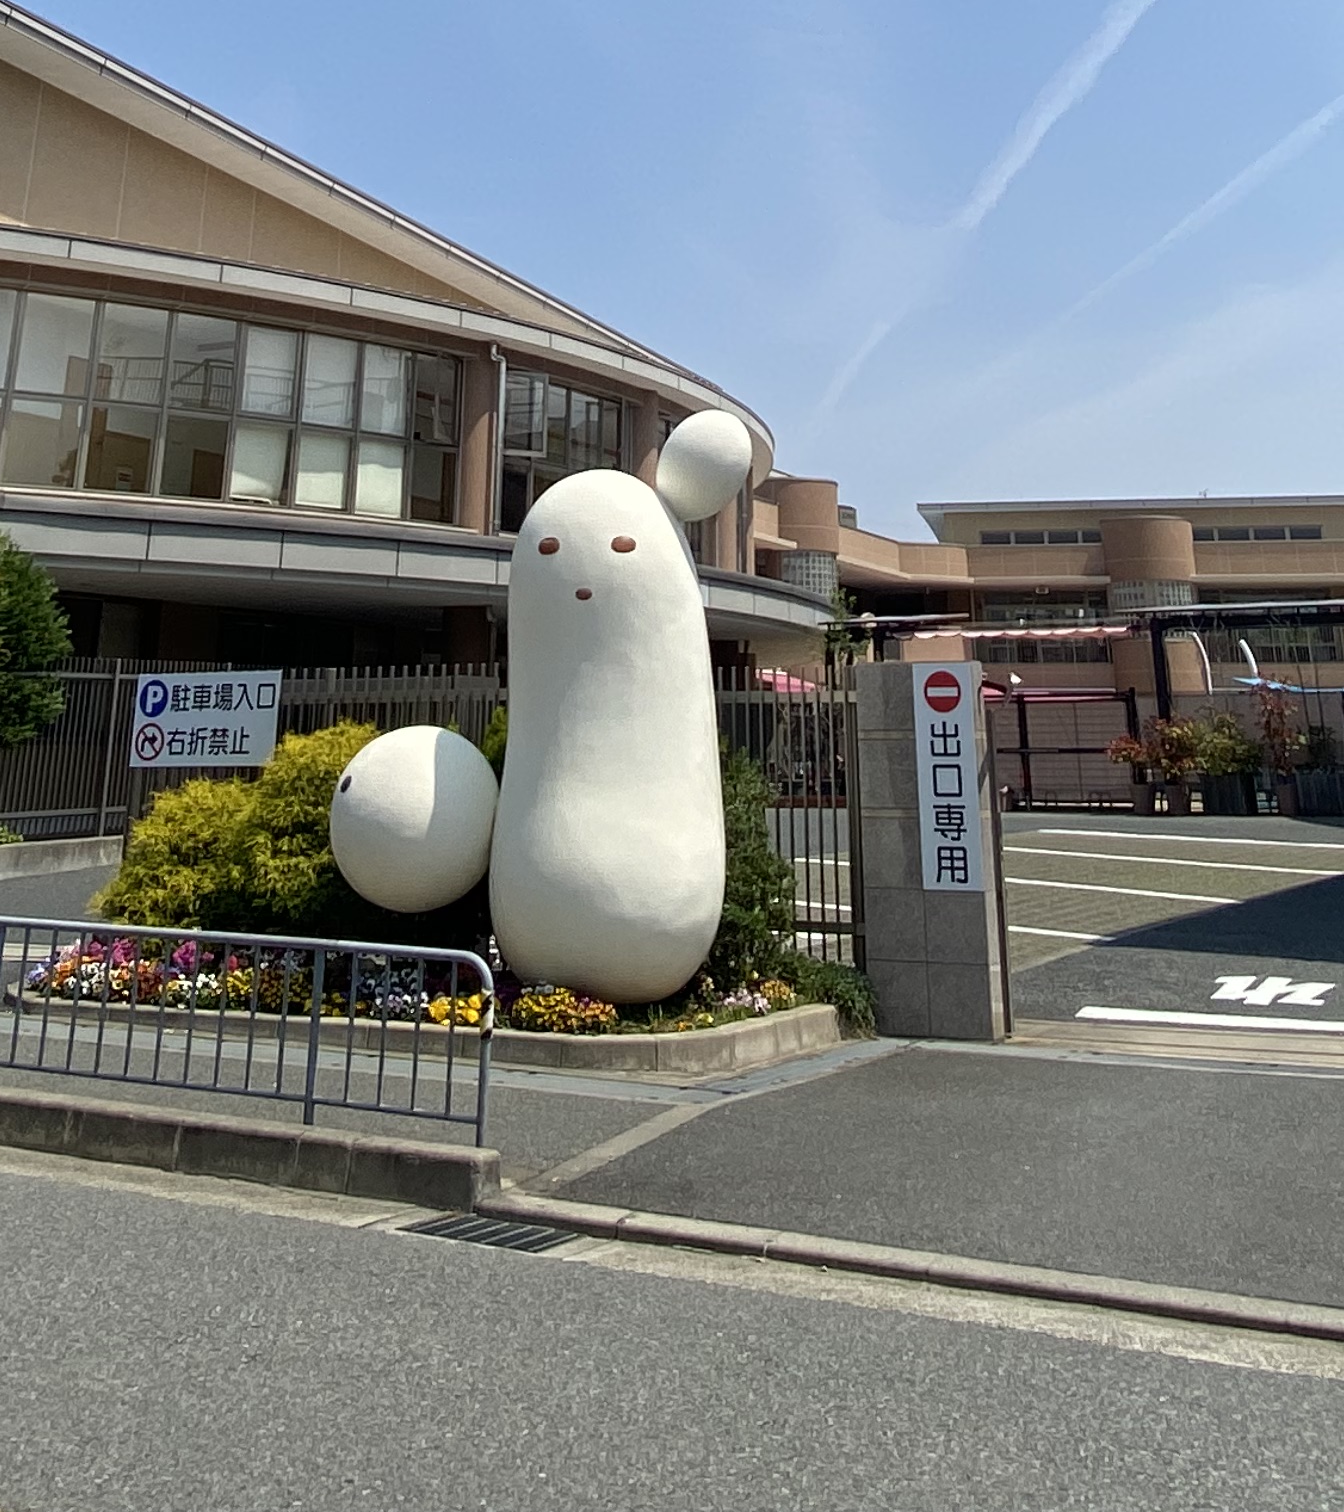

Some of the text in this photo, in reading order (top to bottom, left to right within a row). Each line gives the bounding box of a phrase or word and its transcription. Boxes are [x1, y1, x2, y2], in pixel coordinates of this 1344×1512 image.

[170, 683, 276, 712] 駐車場入口
[167, 727, 250, 756] 右折禁止
[929, 720, 969, 884] 出口専用
